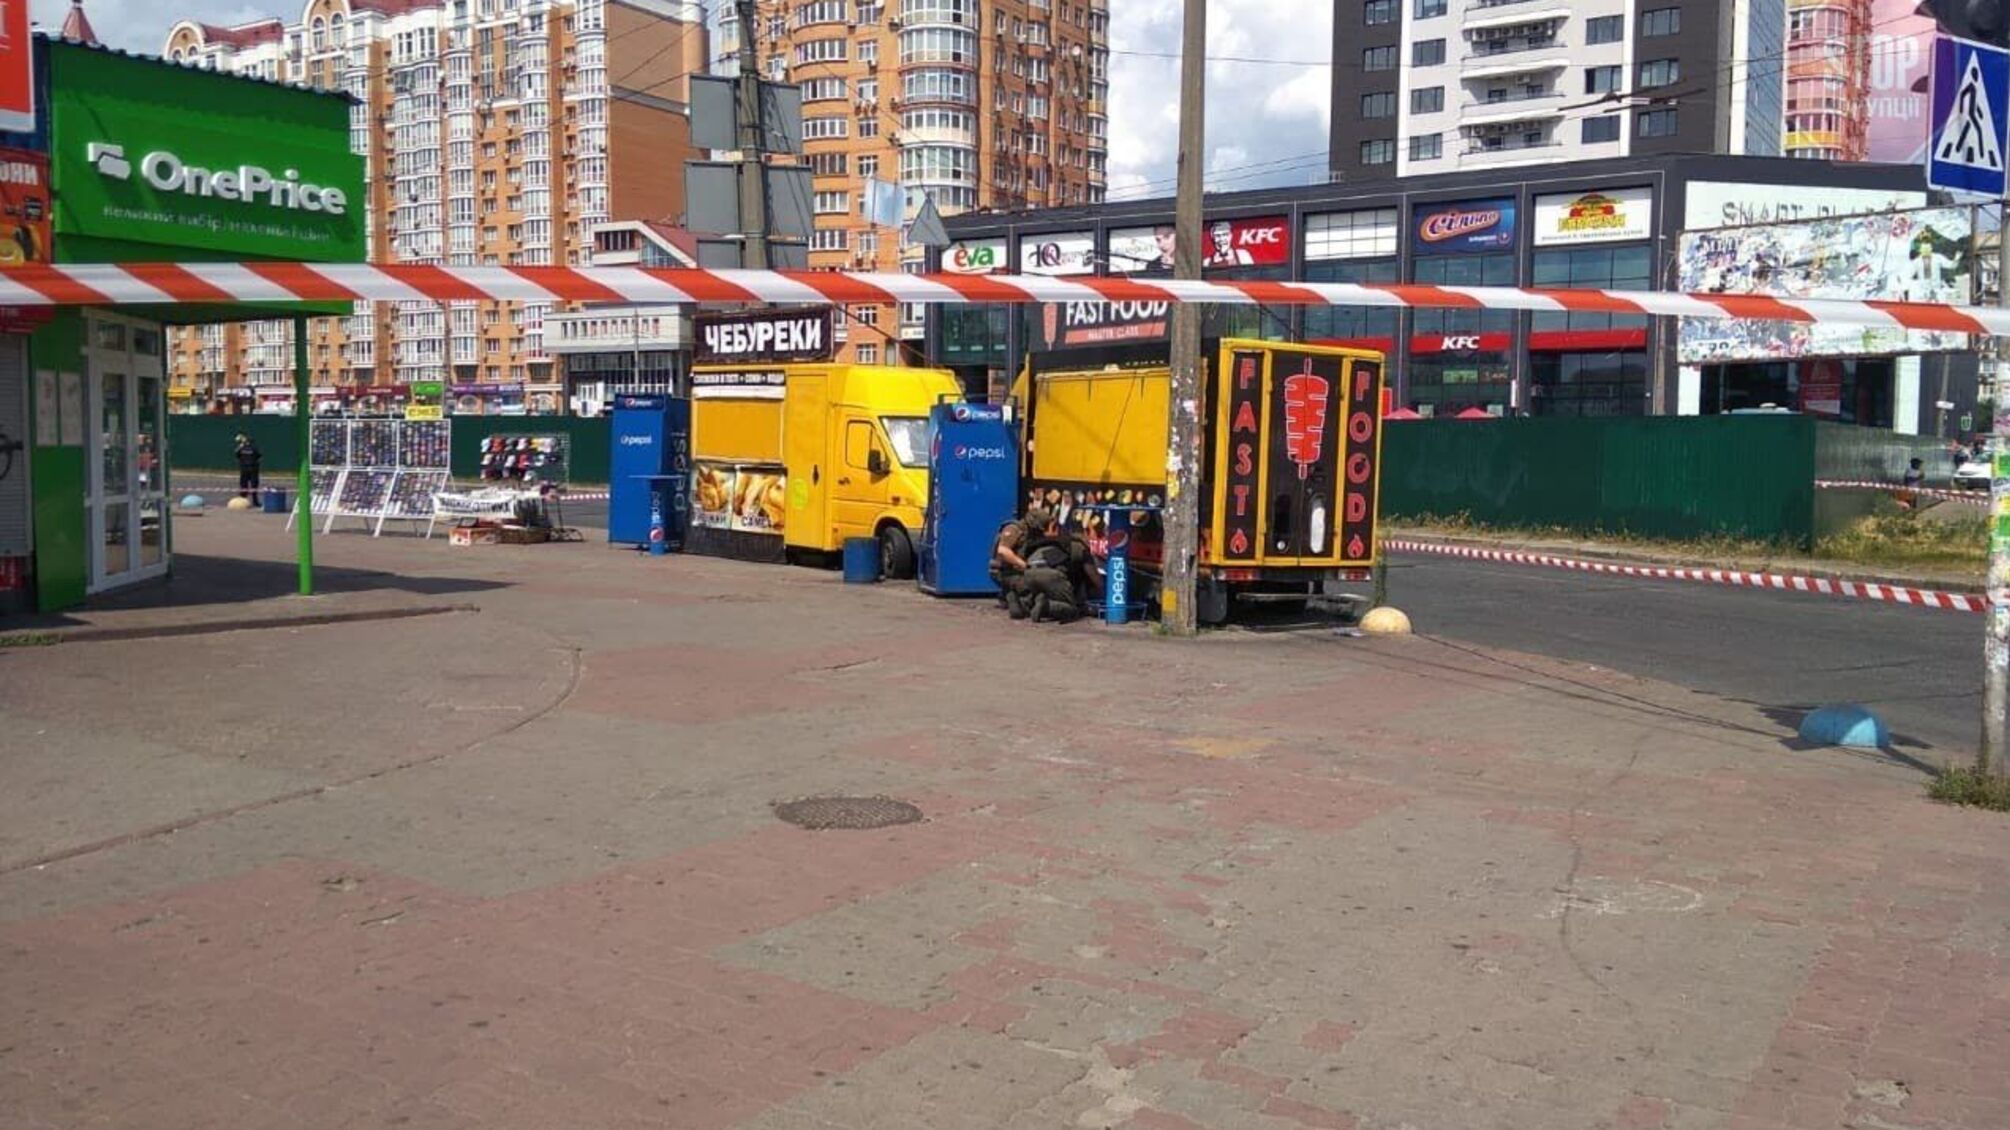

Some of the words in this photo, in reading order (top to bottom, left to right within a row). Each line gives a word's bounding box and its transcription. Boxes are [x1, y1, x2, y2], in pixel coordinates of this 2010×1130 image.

[141, 151, 347, 216] OnePrice
[1239, 227, 1282, 245] KFC
[1065, 301, 1104, 326] FAST
[1110, 300, 1168, 321] FOOD
[705, 319, 822, 353] ЧЕБУРЕКИ
[1441, 336, 1480, 350] KFC
[628, 434, 653, 446] pepsi
[1234, 358, 1257, 516] FAST
[1346, 371, 1373, 522] FOOD
[968, 447, 1006, 460] pepsi
[1112, 556, 1126, 605] pepsi
